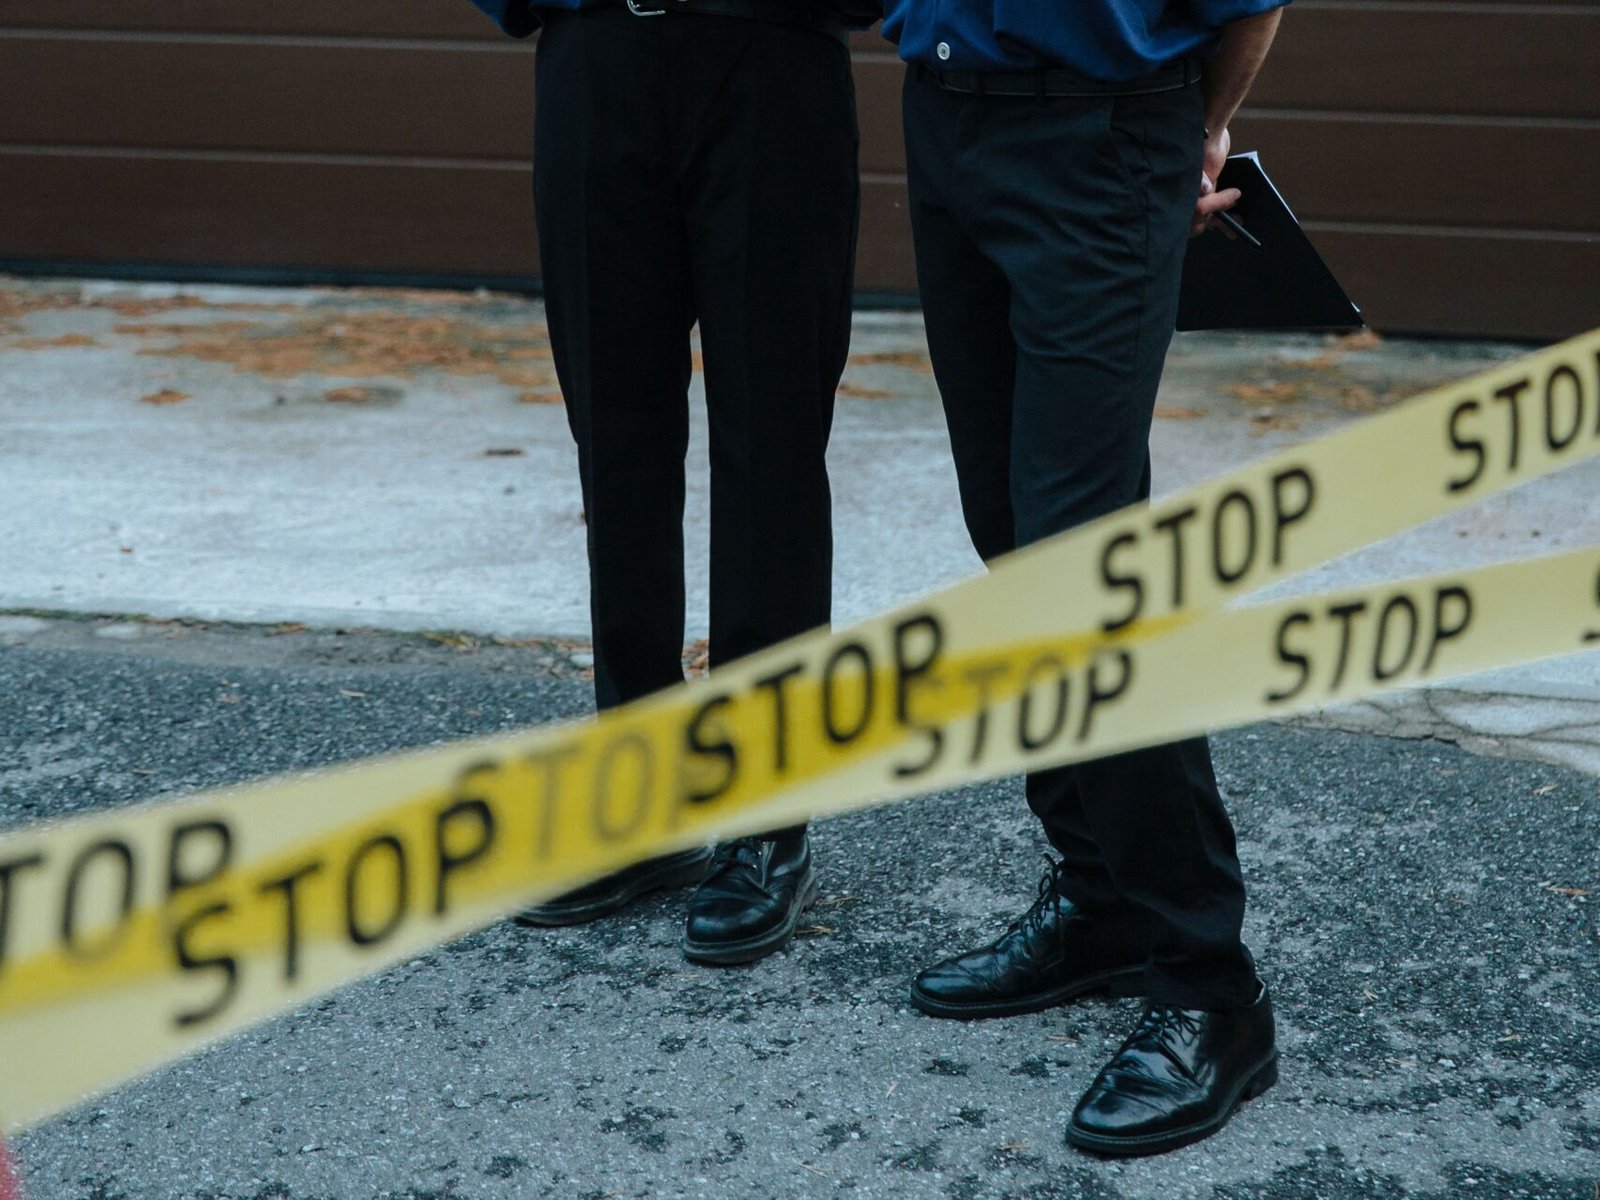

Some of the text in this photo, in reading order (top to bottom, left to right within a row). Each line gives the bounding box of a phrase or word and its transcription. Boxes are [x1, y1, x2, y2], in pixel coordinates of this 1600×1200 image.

[172, 350, 1600, 1029] STOP STOP STOP STO
[1266, 584, 1475, 705] STOP
